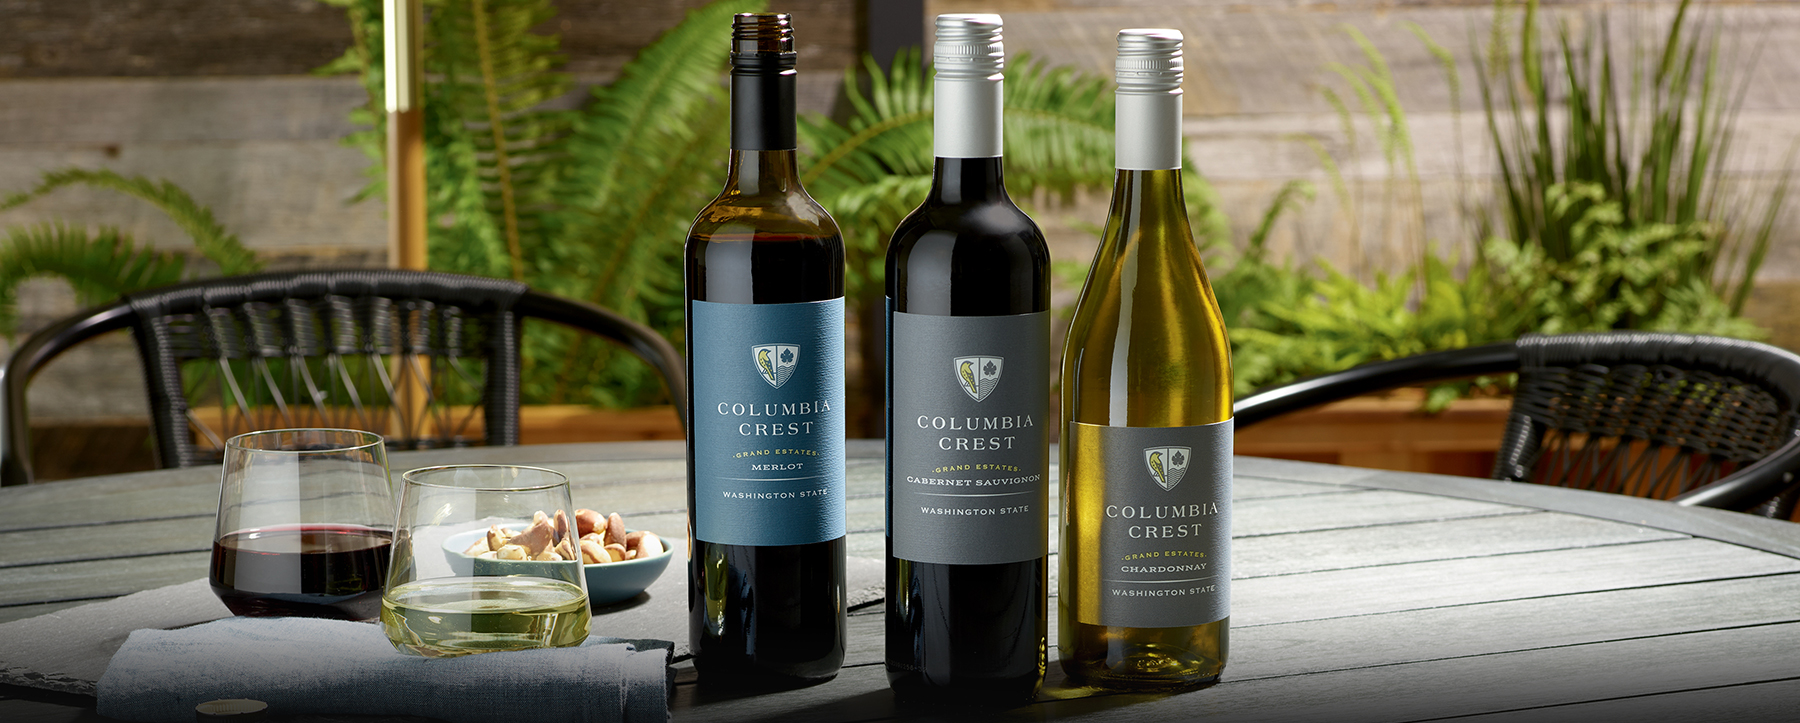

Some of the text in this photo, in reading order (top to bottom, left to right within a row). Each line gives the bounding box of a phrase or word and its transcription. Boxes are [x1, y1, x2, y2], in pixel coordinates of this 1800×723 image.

[717, 400, 831, 417] COLUMBIA
[739, 422, 814, 436] CREST
[917, 414, 1034, 431] COLUMBIA
[939, 436, 1016, 451] CREST
[751, 463, 804, 471] MERLOT
[907, 474, 1041, 487] CABERNET SAUVIGNON
[723, 489, 828, 499] WASHINGTON STATE
[920, 505, 1029, 516] WASHINGTON STATE
[1106, 502, 1218, 519] COLUMBIA
[1128, 523, 1202, 539] CREST
[1121, 563, 1207, 573] CHARDONNAY
[1112, 585, 1216, 597] WASHINGTON STATE
